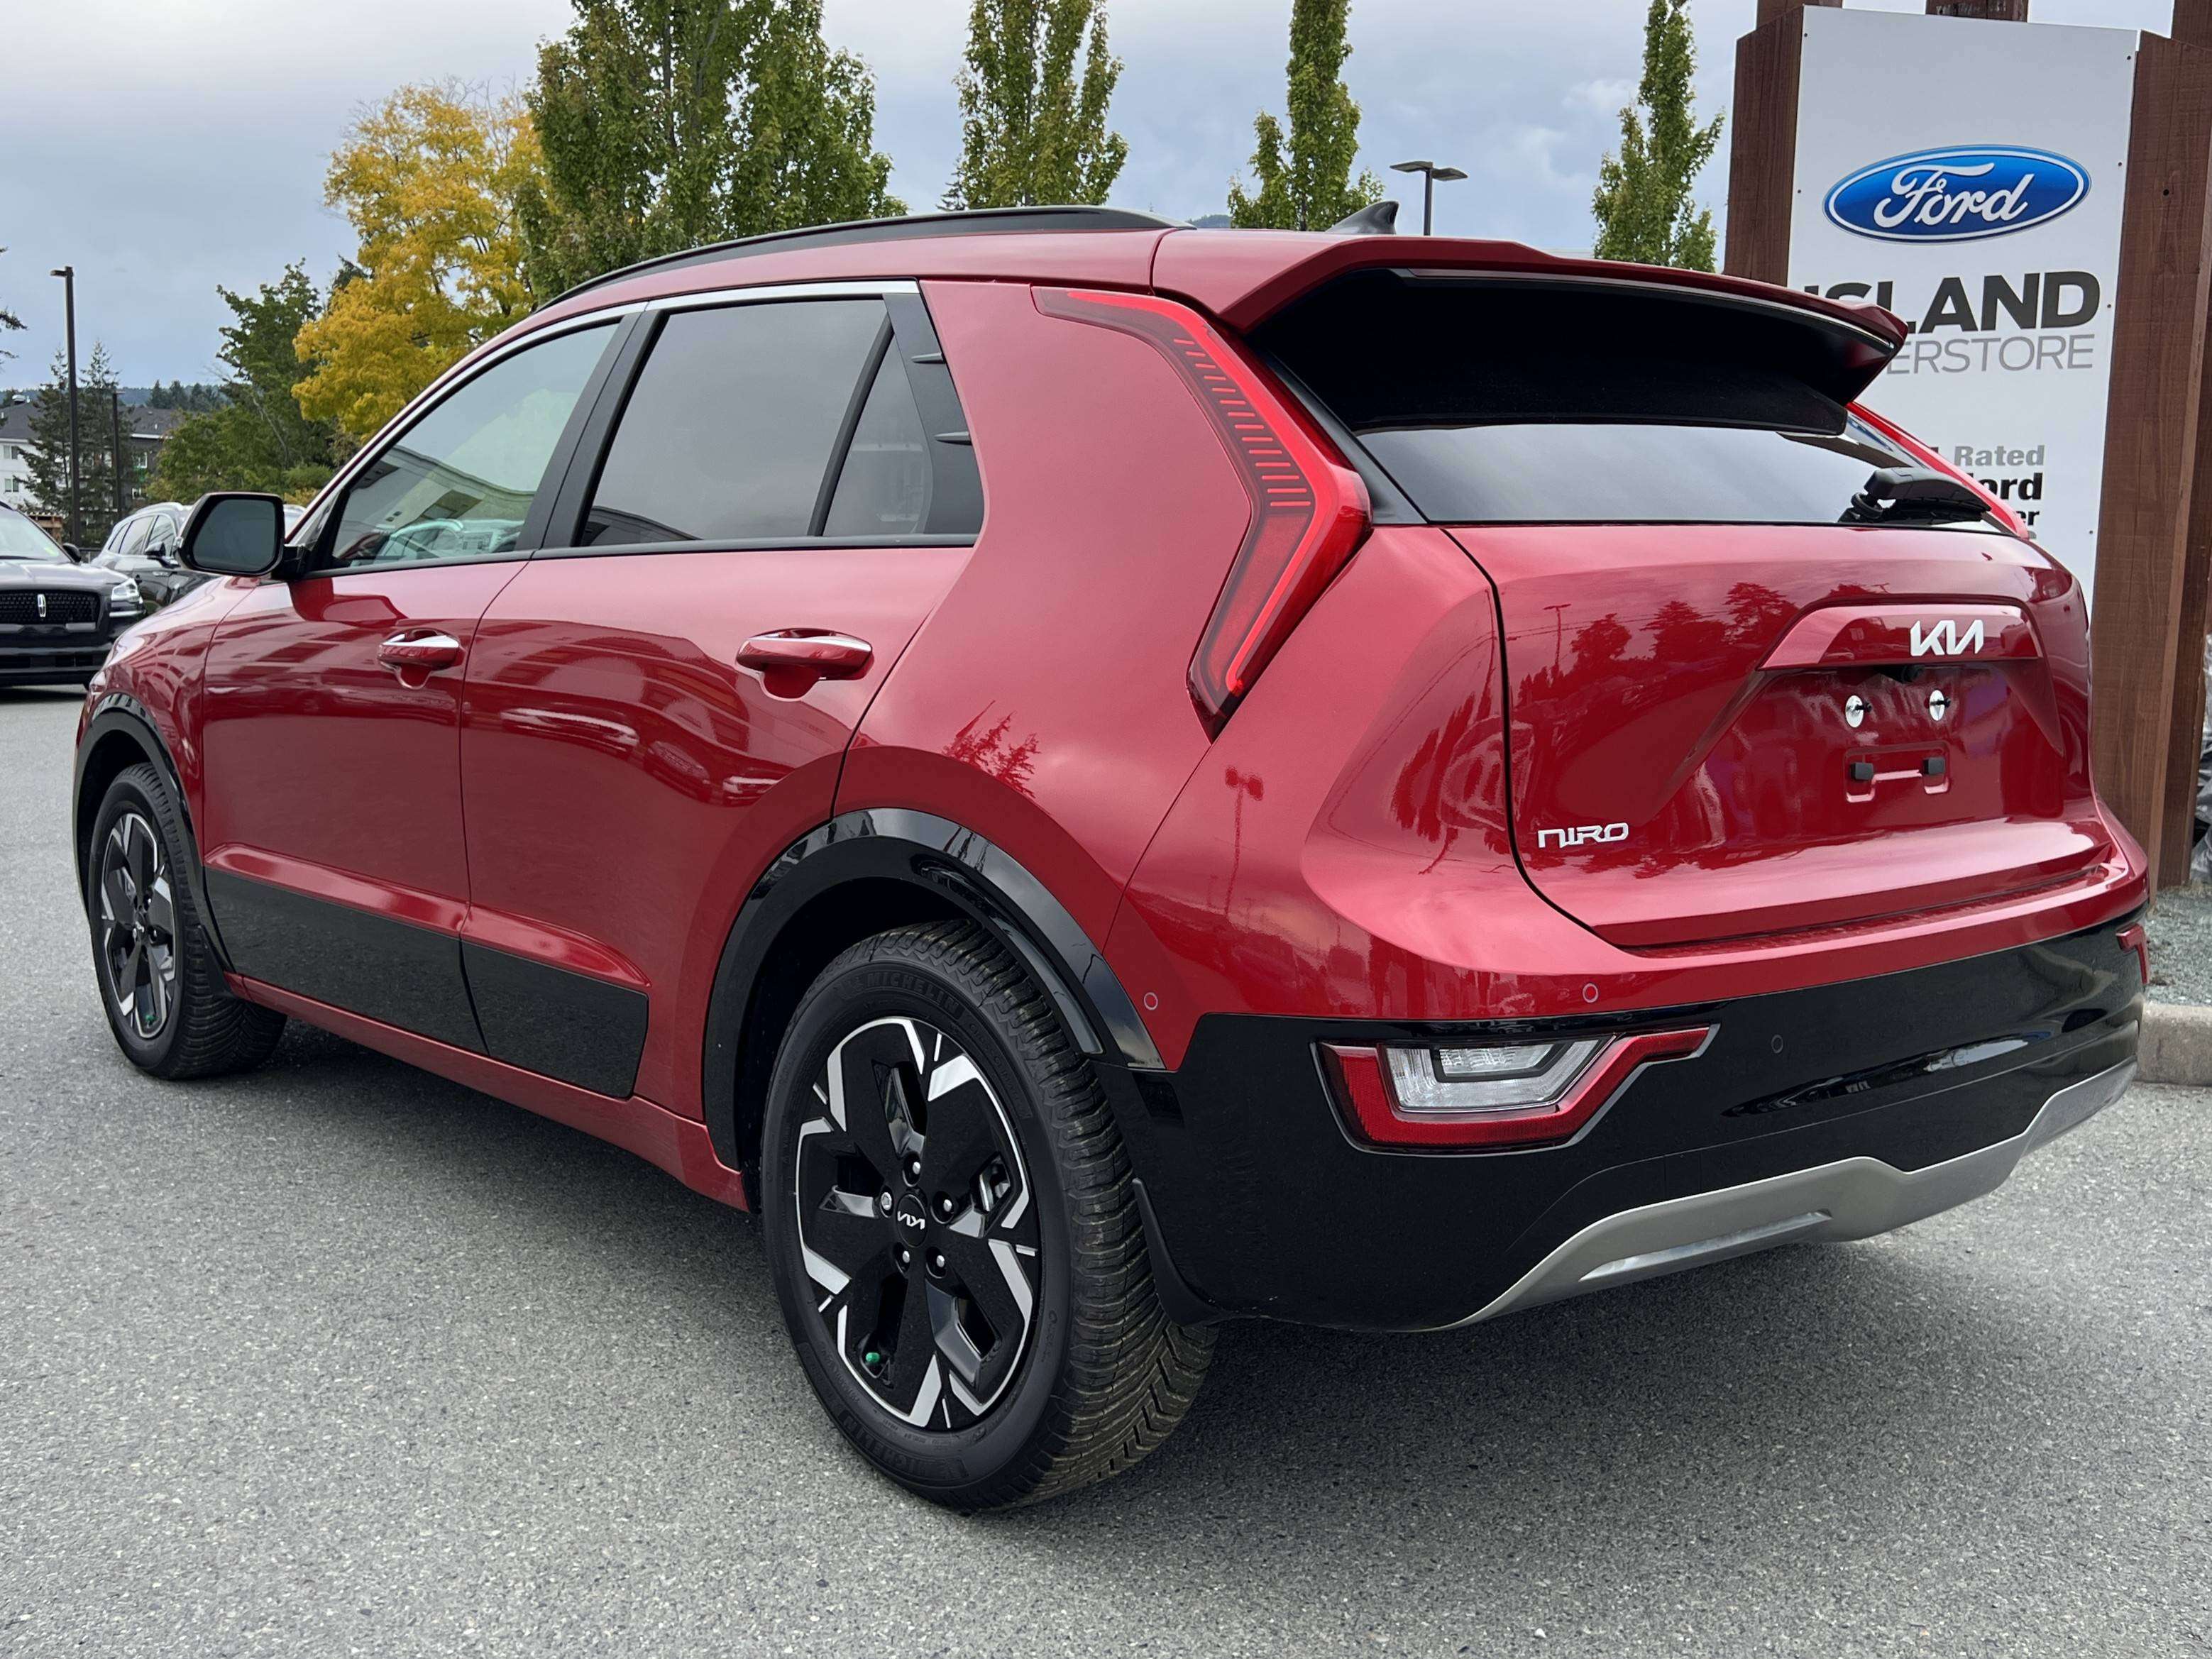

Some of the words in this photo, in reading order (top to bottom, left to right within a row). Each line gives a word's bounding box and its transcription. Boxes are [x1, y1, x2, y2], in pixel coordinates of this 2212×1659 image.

[1873, 162, 2035, 228] Ford
[1804, 271, 2101, 334] LAND
[1887, 334, 2095, 375] ERSTORE
[1954, 445, 2045, 466] Rated
[1969, 473, 2043, 500] ord
[1910, 619, 1984, 656] KIA
[1537, 822, 1629, 849] NIRO
[866, 972, 960, 1014] MICHELIN
